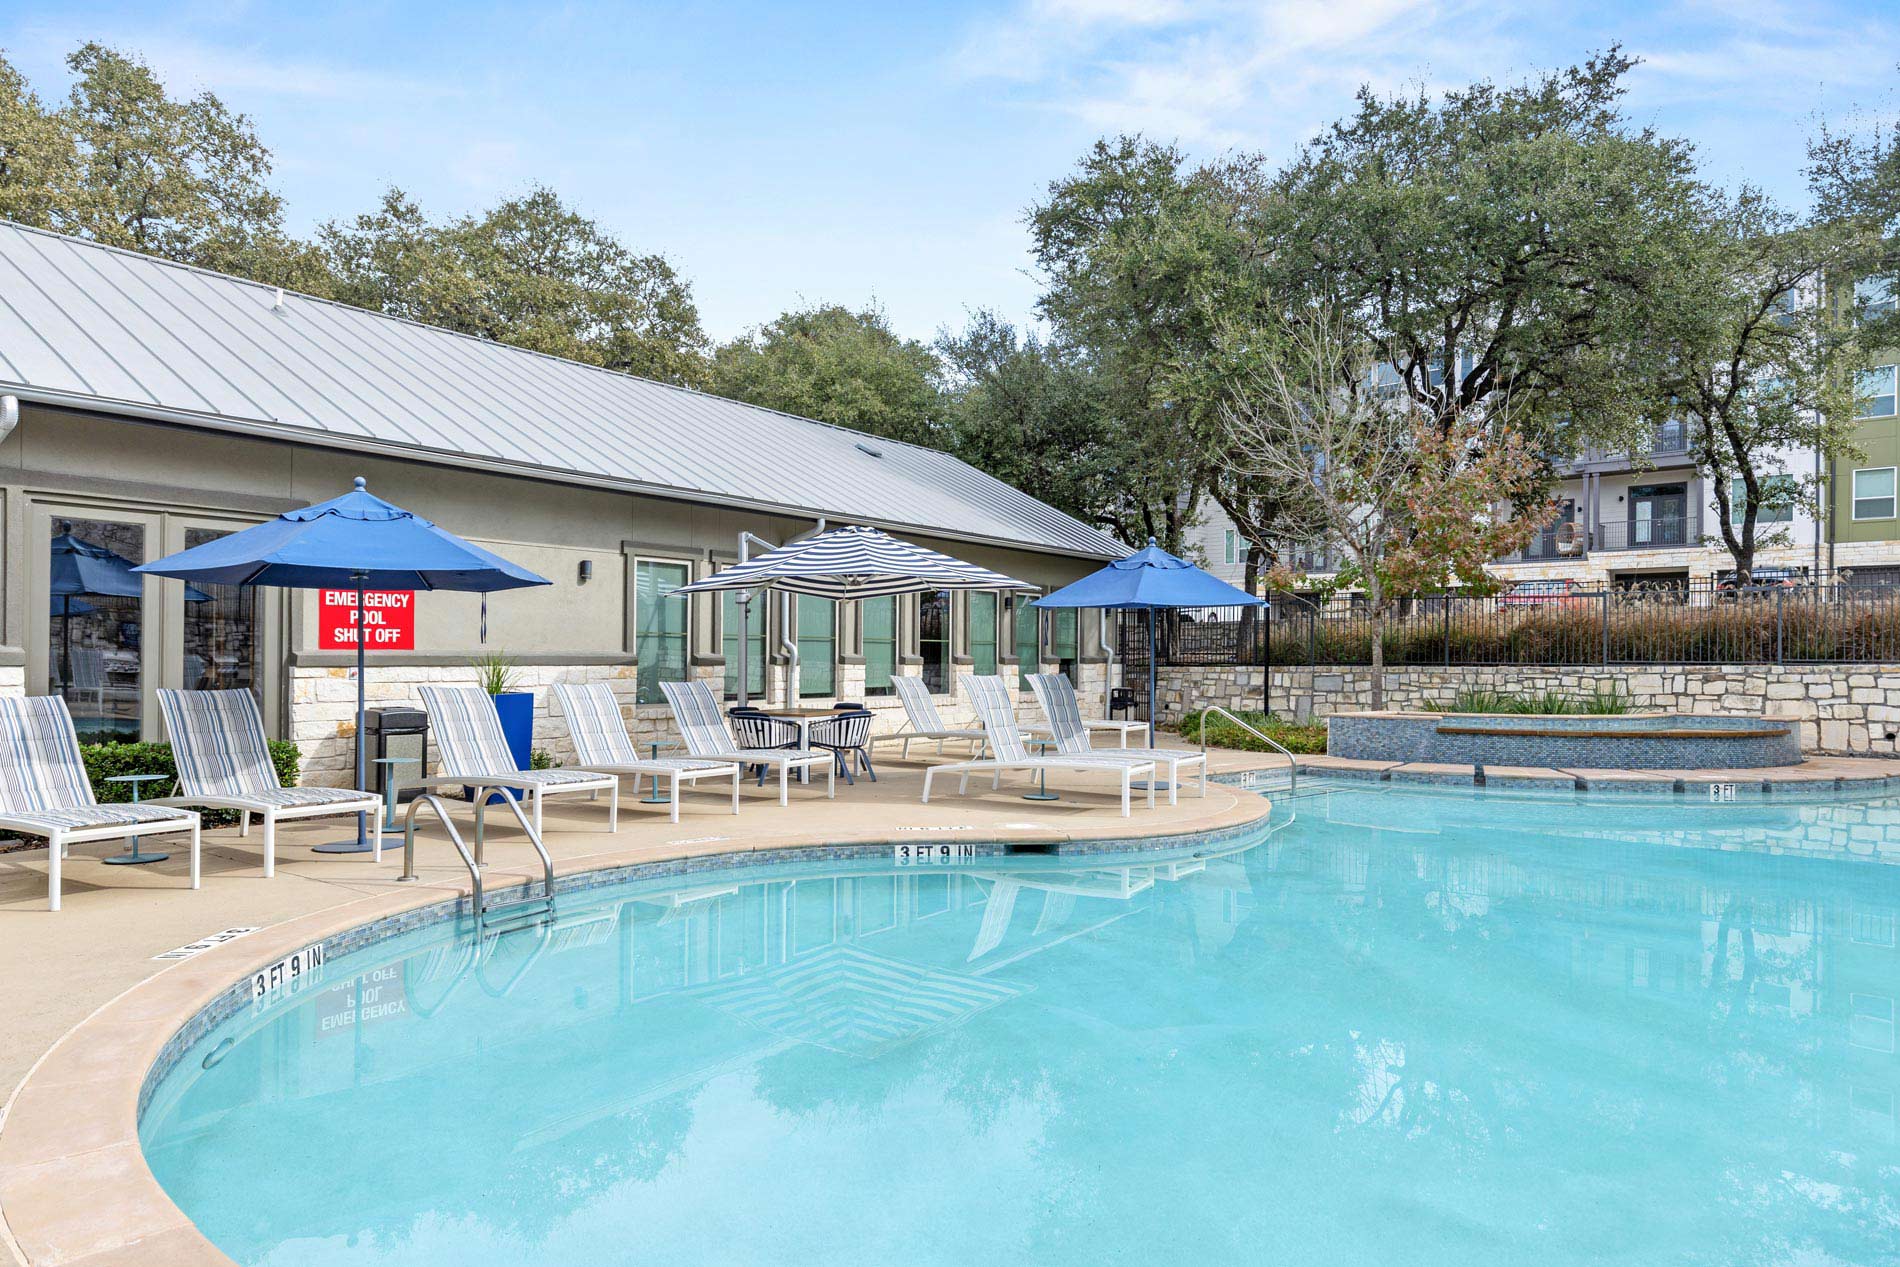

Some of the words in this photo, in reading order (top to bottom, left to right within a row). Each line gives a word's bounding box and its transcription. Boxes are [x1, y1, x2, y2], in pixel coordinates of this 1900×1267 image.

[375, 628, 401, 643] OFF
[900, 845, 910, 857] 3
[916, 845, 934, 857] FT
[940, 845, 950, 857] 9
[958, 845, 973, 857] IN
[256, 974, 266, 996] 3
[270, 961, 285, 989] FT
[291, 955, 301, 977] 9
[306, 945, 321, 970] IN
